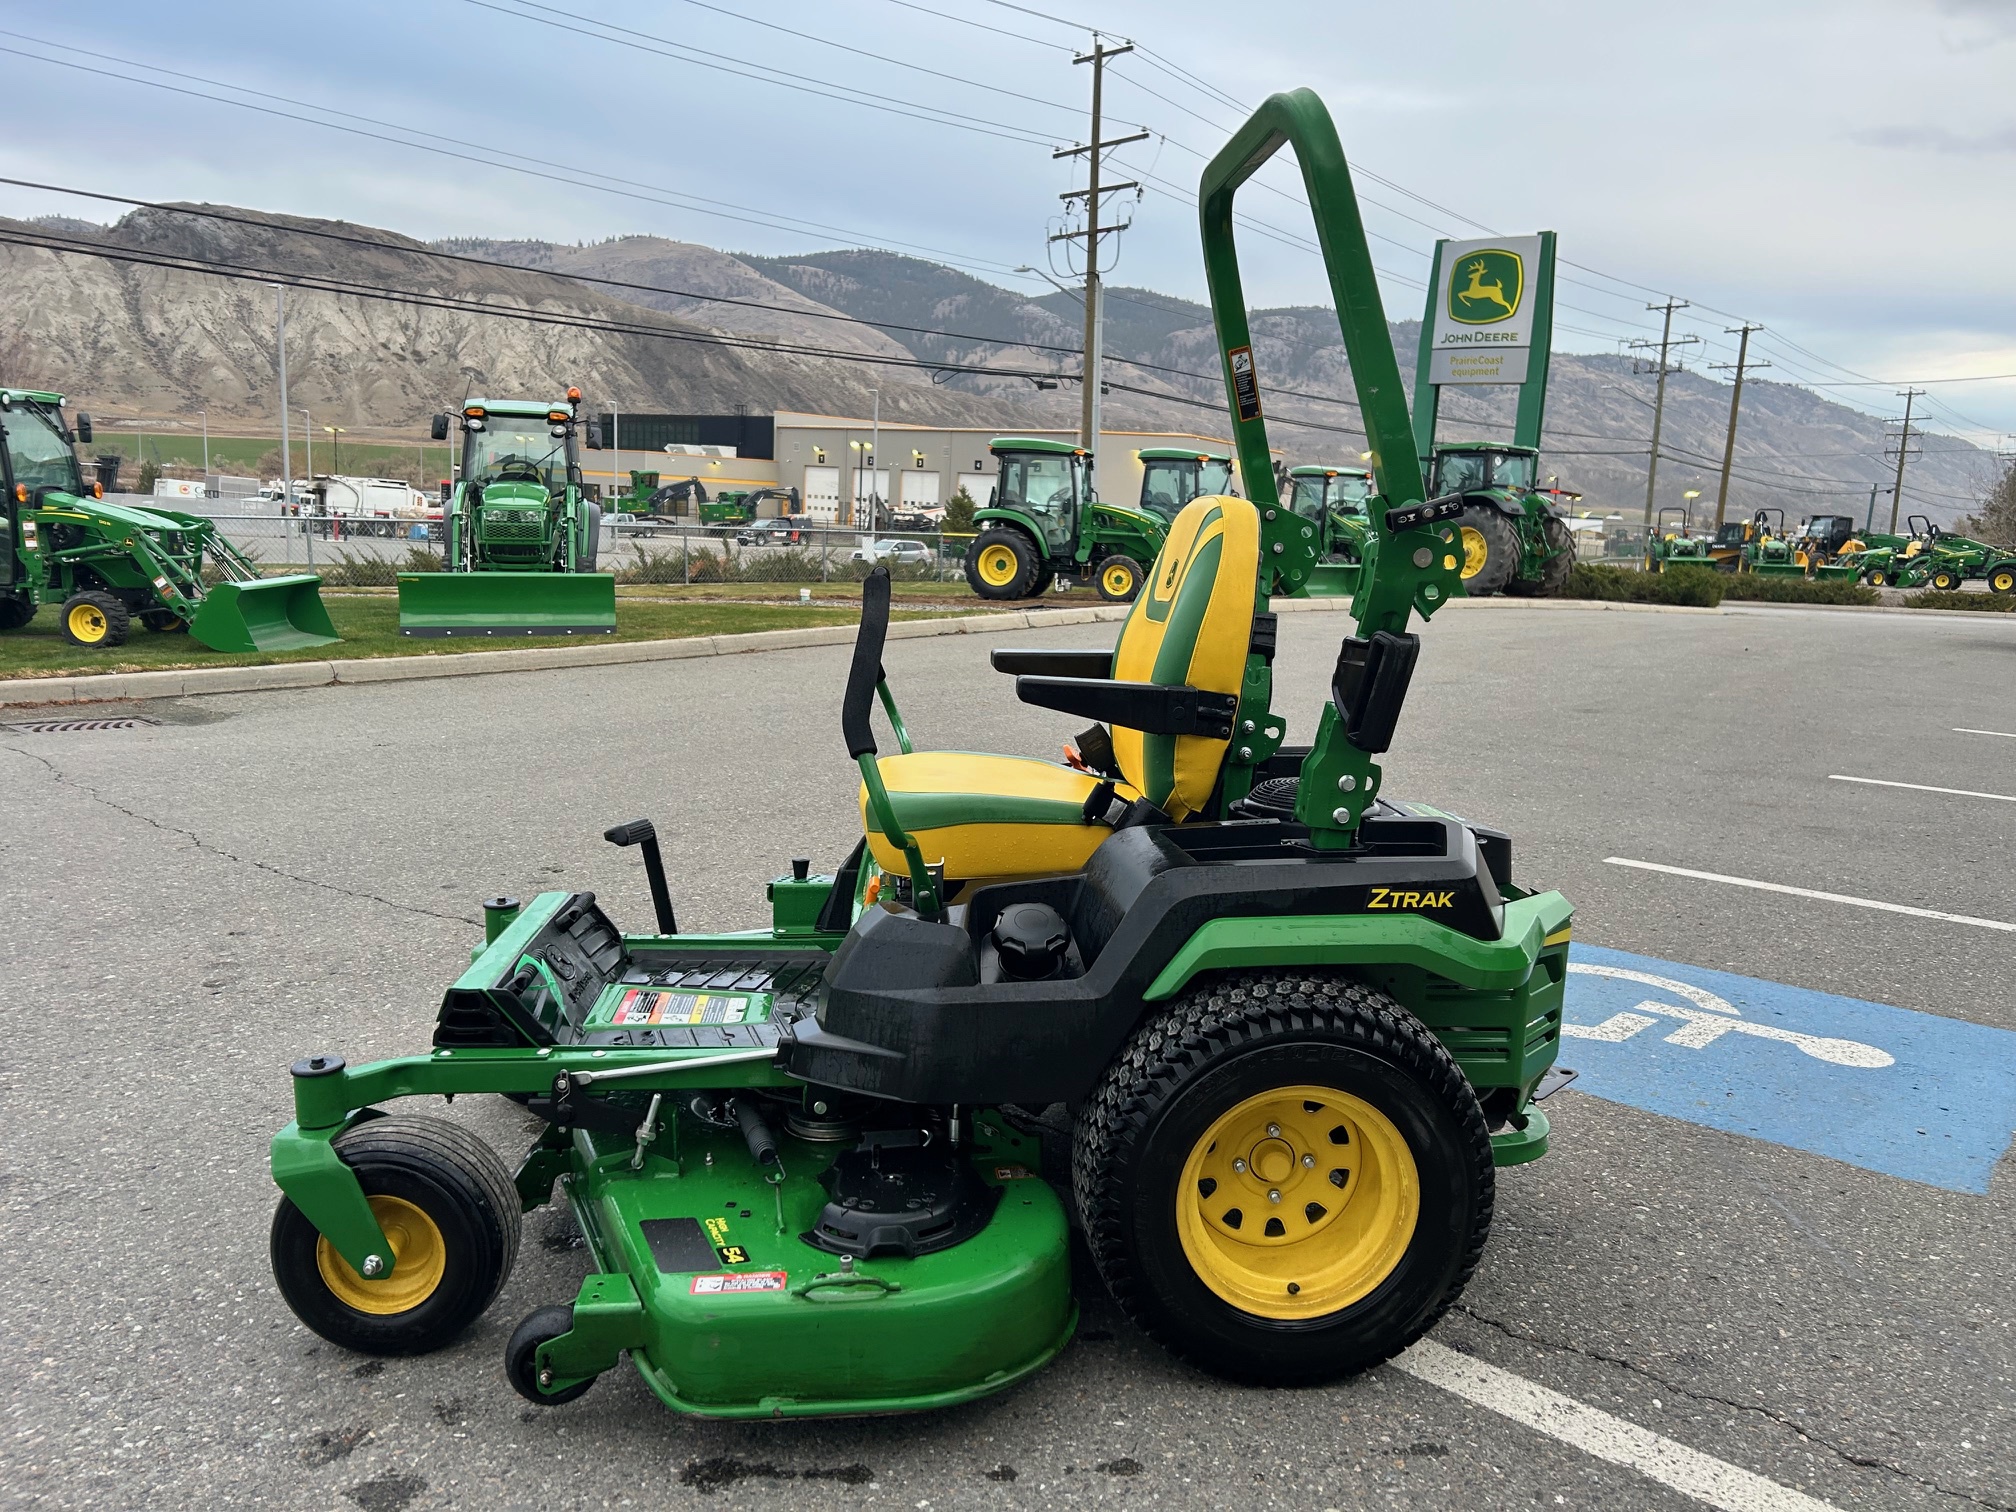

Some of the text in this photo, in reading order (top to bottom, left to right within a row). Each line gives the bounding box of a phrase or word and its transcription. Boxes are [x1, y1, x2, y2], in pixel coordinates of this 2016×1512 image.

[1440, 331, 1518, 344] JOHN DEERE
[1450, 355, 1504, 365] PrairieCoast
[1451, 367, 1500, 377] equipment
[1367, 888, 1455, 908] ZTRAK
[722, 1246, 745, 1264] 54
